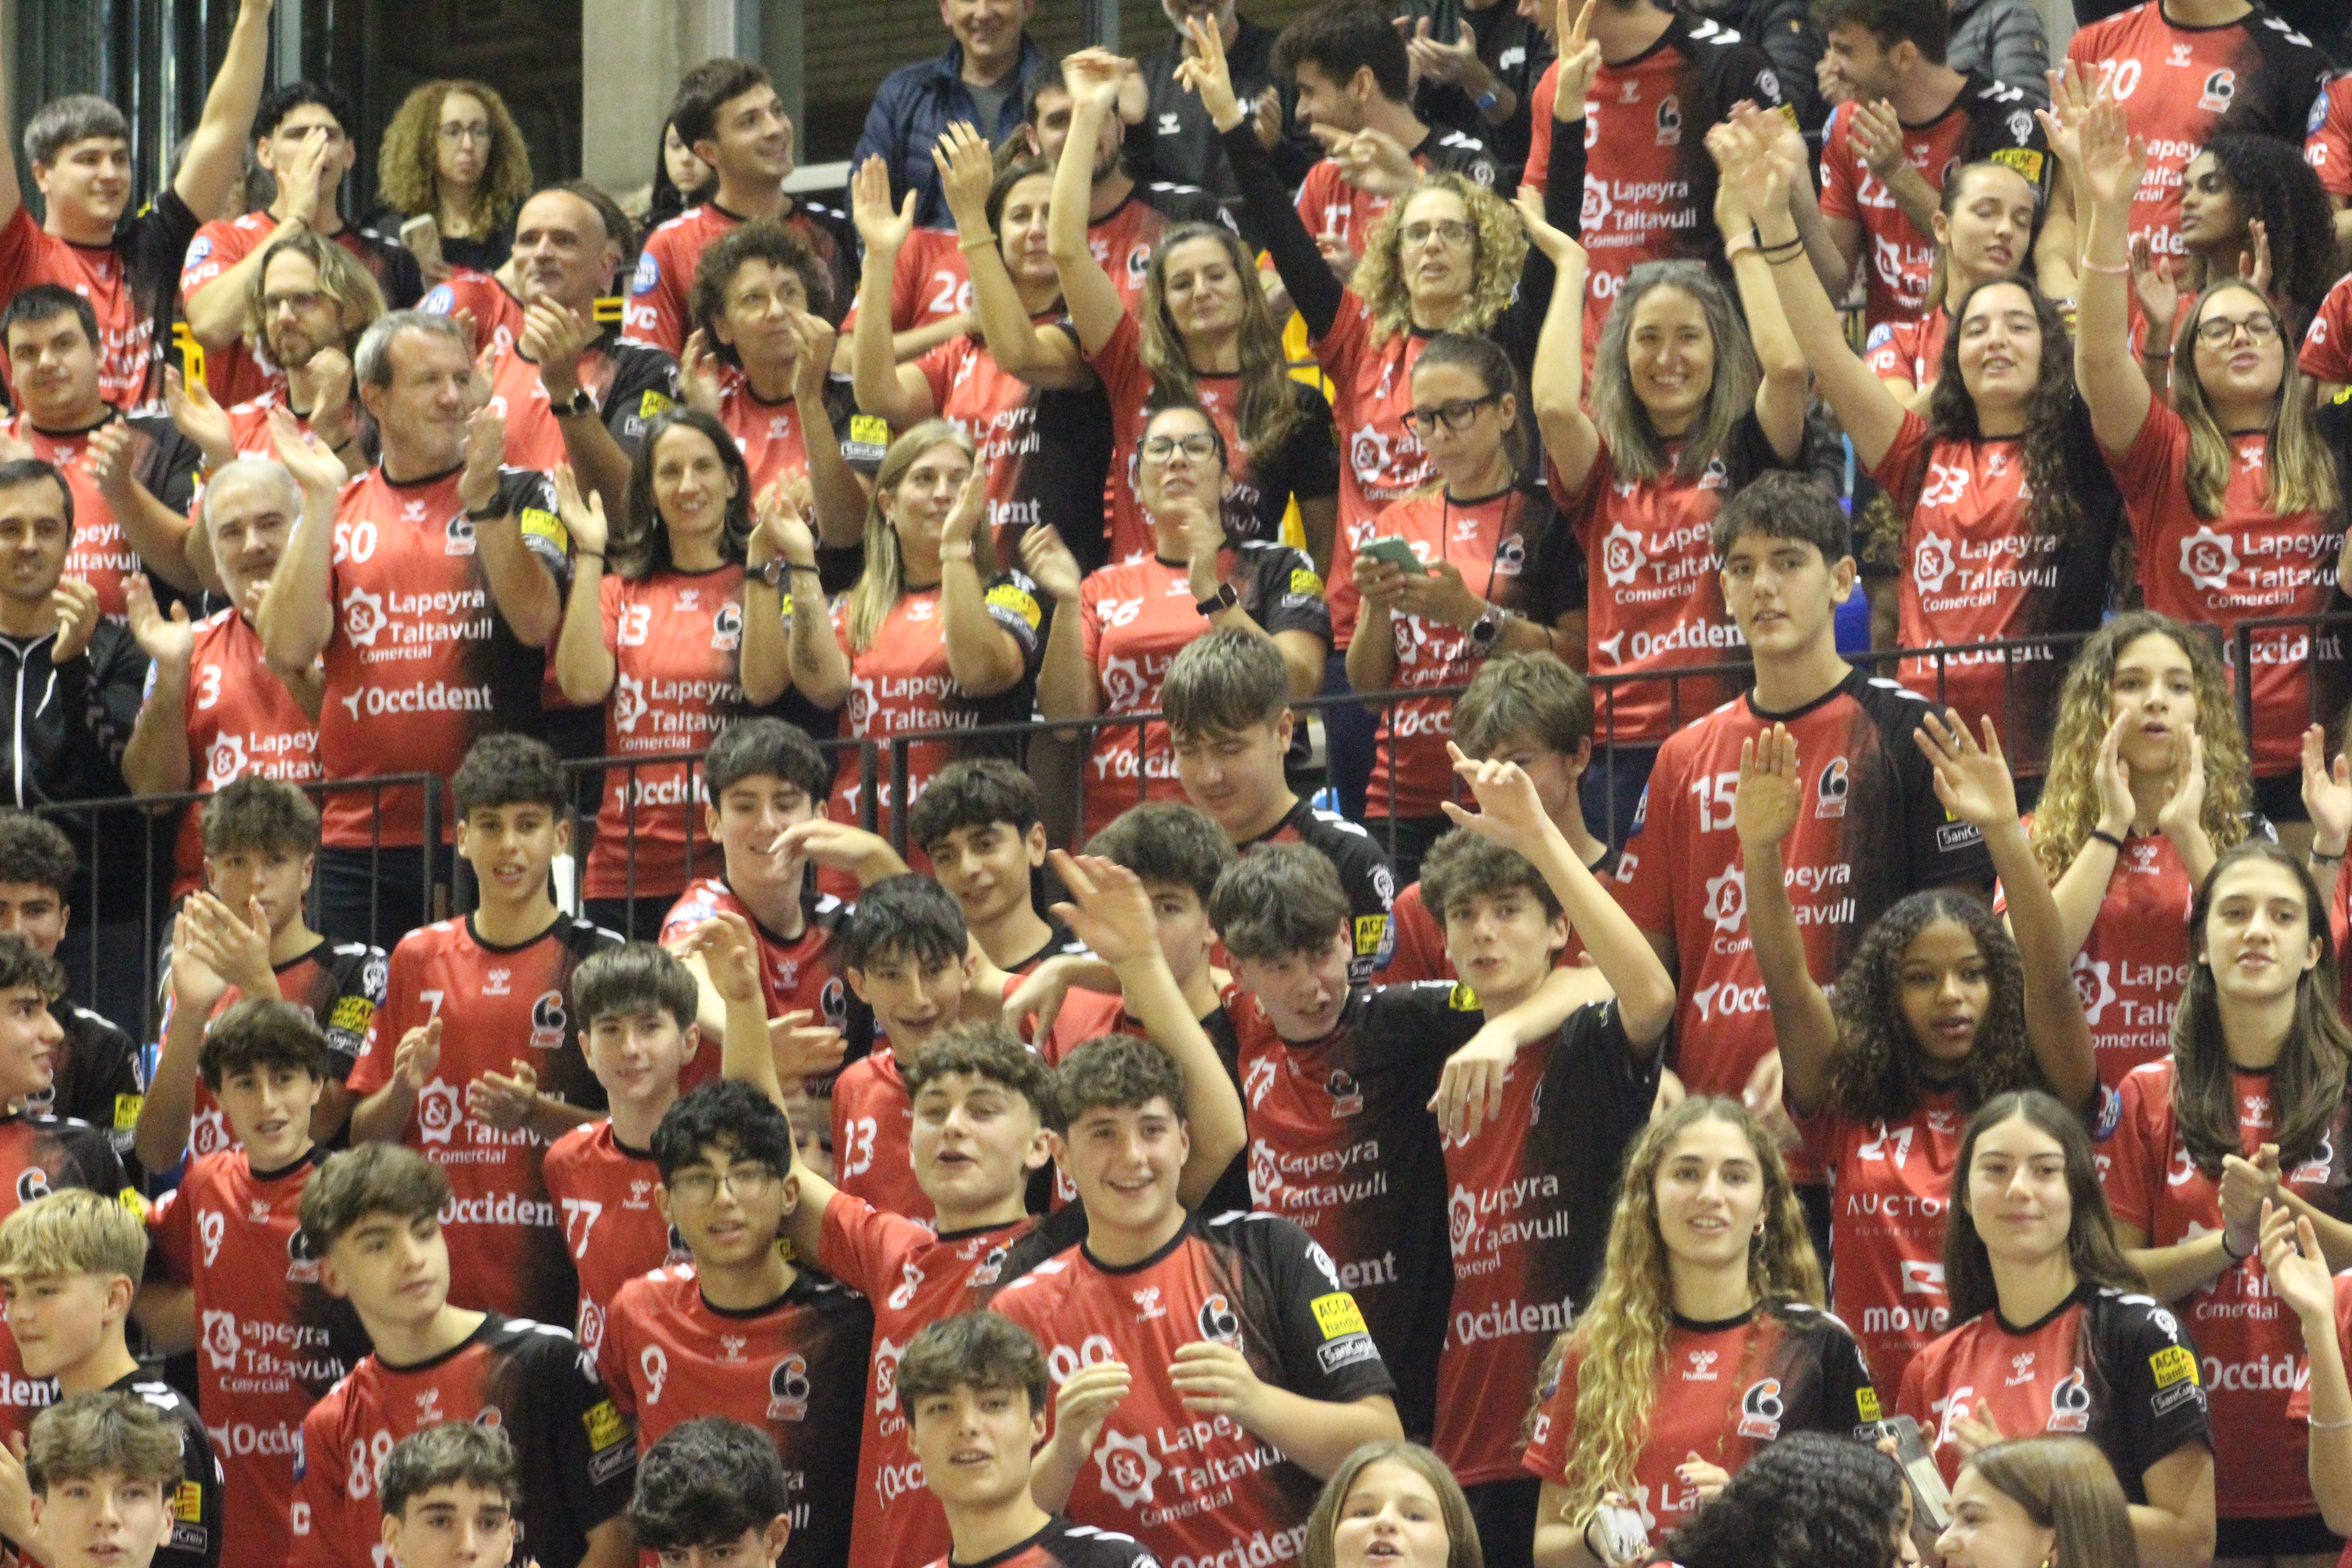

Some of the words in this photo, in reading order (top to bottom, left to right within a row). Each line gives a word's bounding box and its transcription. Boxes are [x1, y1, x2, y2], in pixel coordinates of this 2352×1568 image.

[1612, 179, 1689, 206] Lapeyra
[1613, 207, 1697, 231] Taltavull
[1960, 533, 2057, 561] Lapeyra
[1615, 579, 1697, 605] Comercial
[1957, 566, 2058, 593] Taltavull
[388, 588, 485, 616] Lapeyra
[1923, 591, 1997, 613] Comercial
[2207, 588, 2295, 610] Comercial
[388, 617, 493, 644] Taltavull
[1631, 617, 1746, 660] Occiden
[360, 643, 432, 664] Comercial
[365, 681, 494, 715] Occident
[428, 1146, 507, 1165] Comercial
[1847, 1194, 1952, 1217] AUCTO
[2195, 1301, 2278, 1321] Comercial
[1141, 1485, 1235, 1529] Comercial
